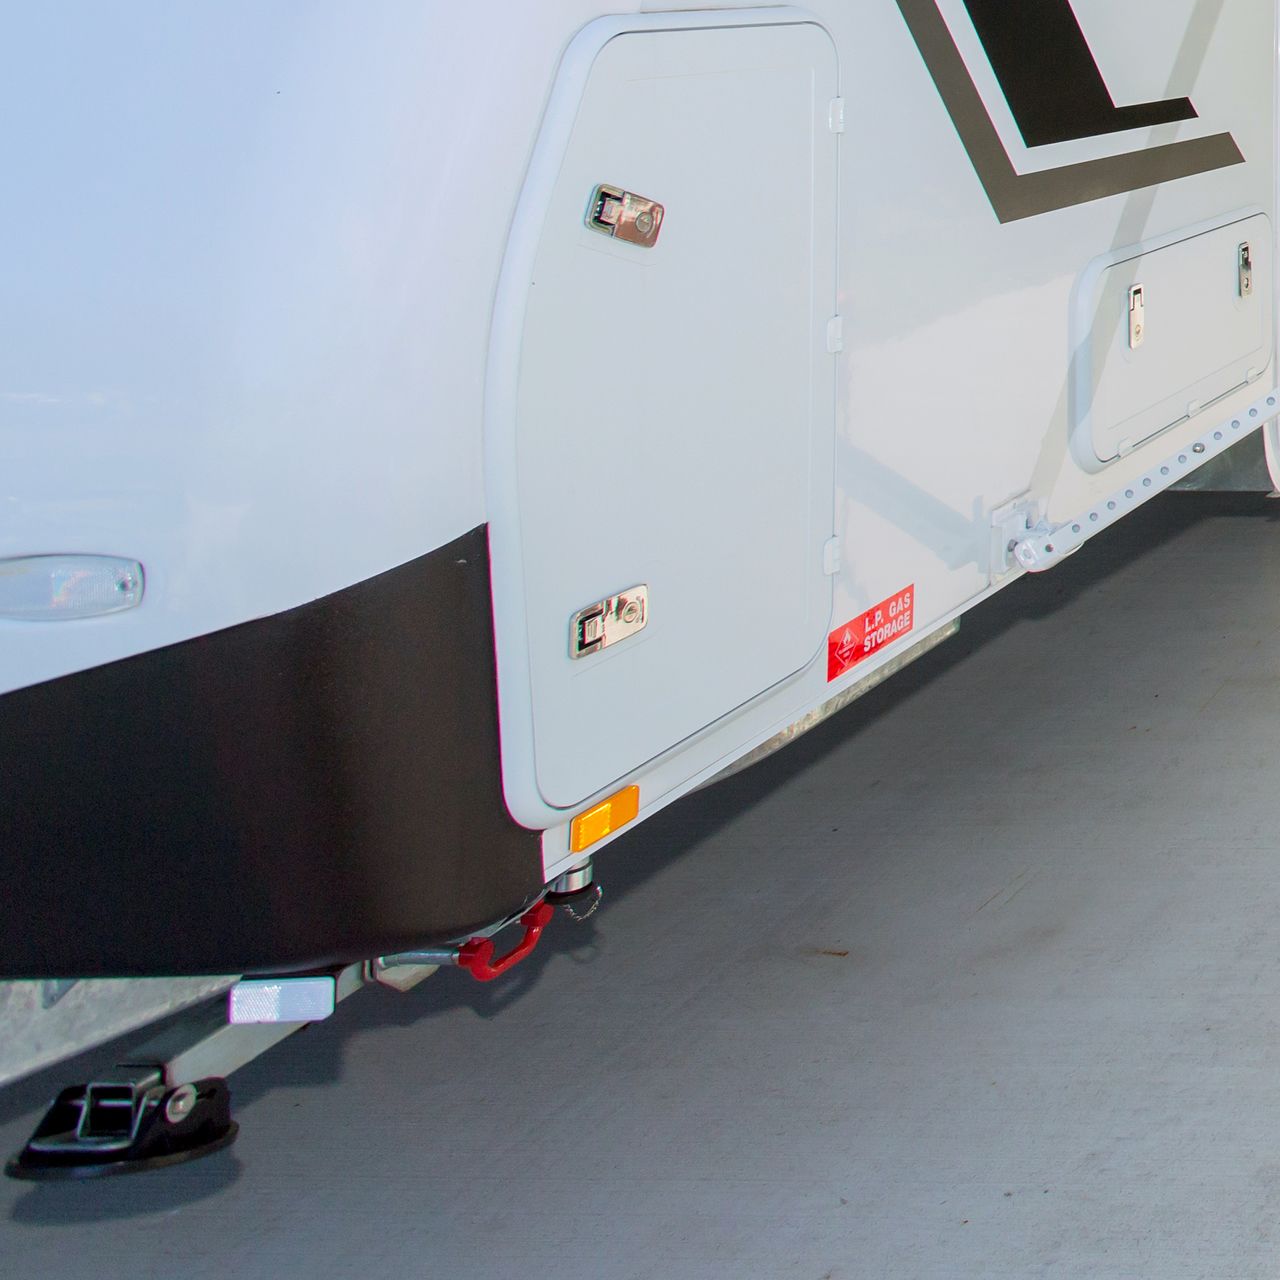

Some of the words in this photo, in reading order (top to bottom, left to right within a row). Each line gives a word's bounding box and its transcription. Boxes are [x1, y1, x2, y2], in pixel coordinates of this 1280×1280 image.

[863, 610, 911, 652] STORAGE
[864, 610, 884, 633] L.P.
[889, 592, 911, 617] GAS
